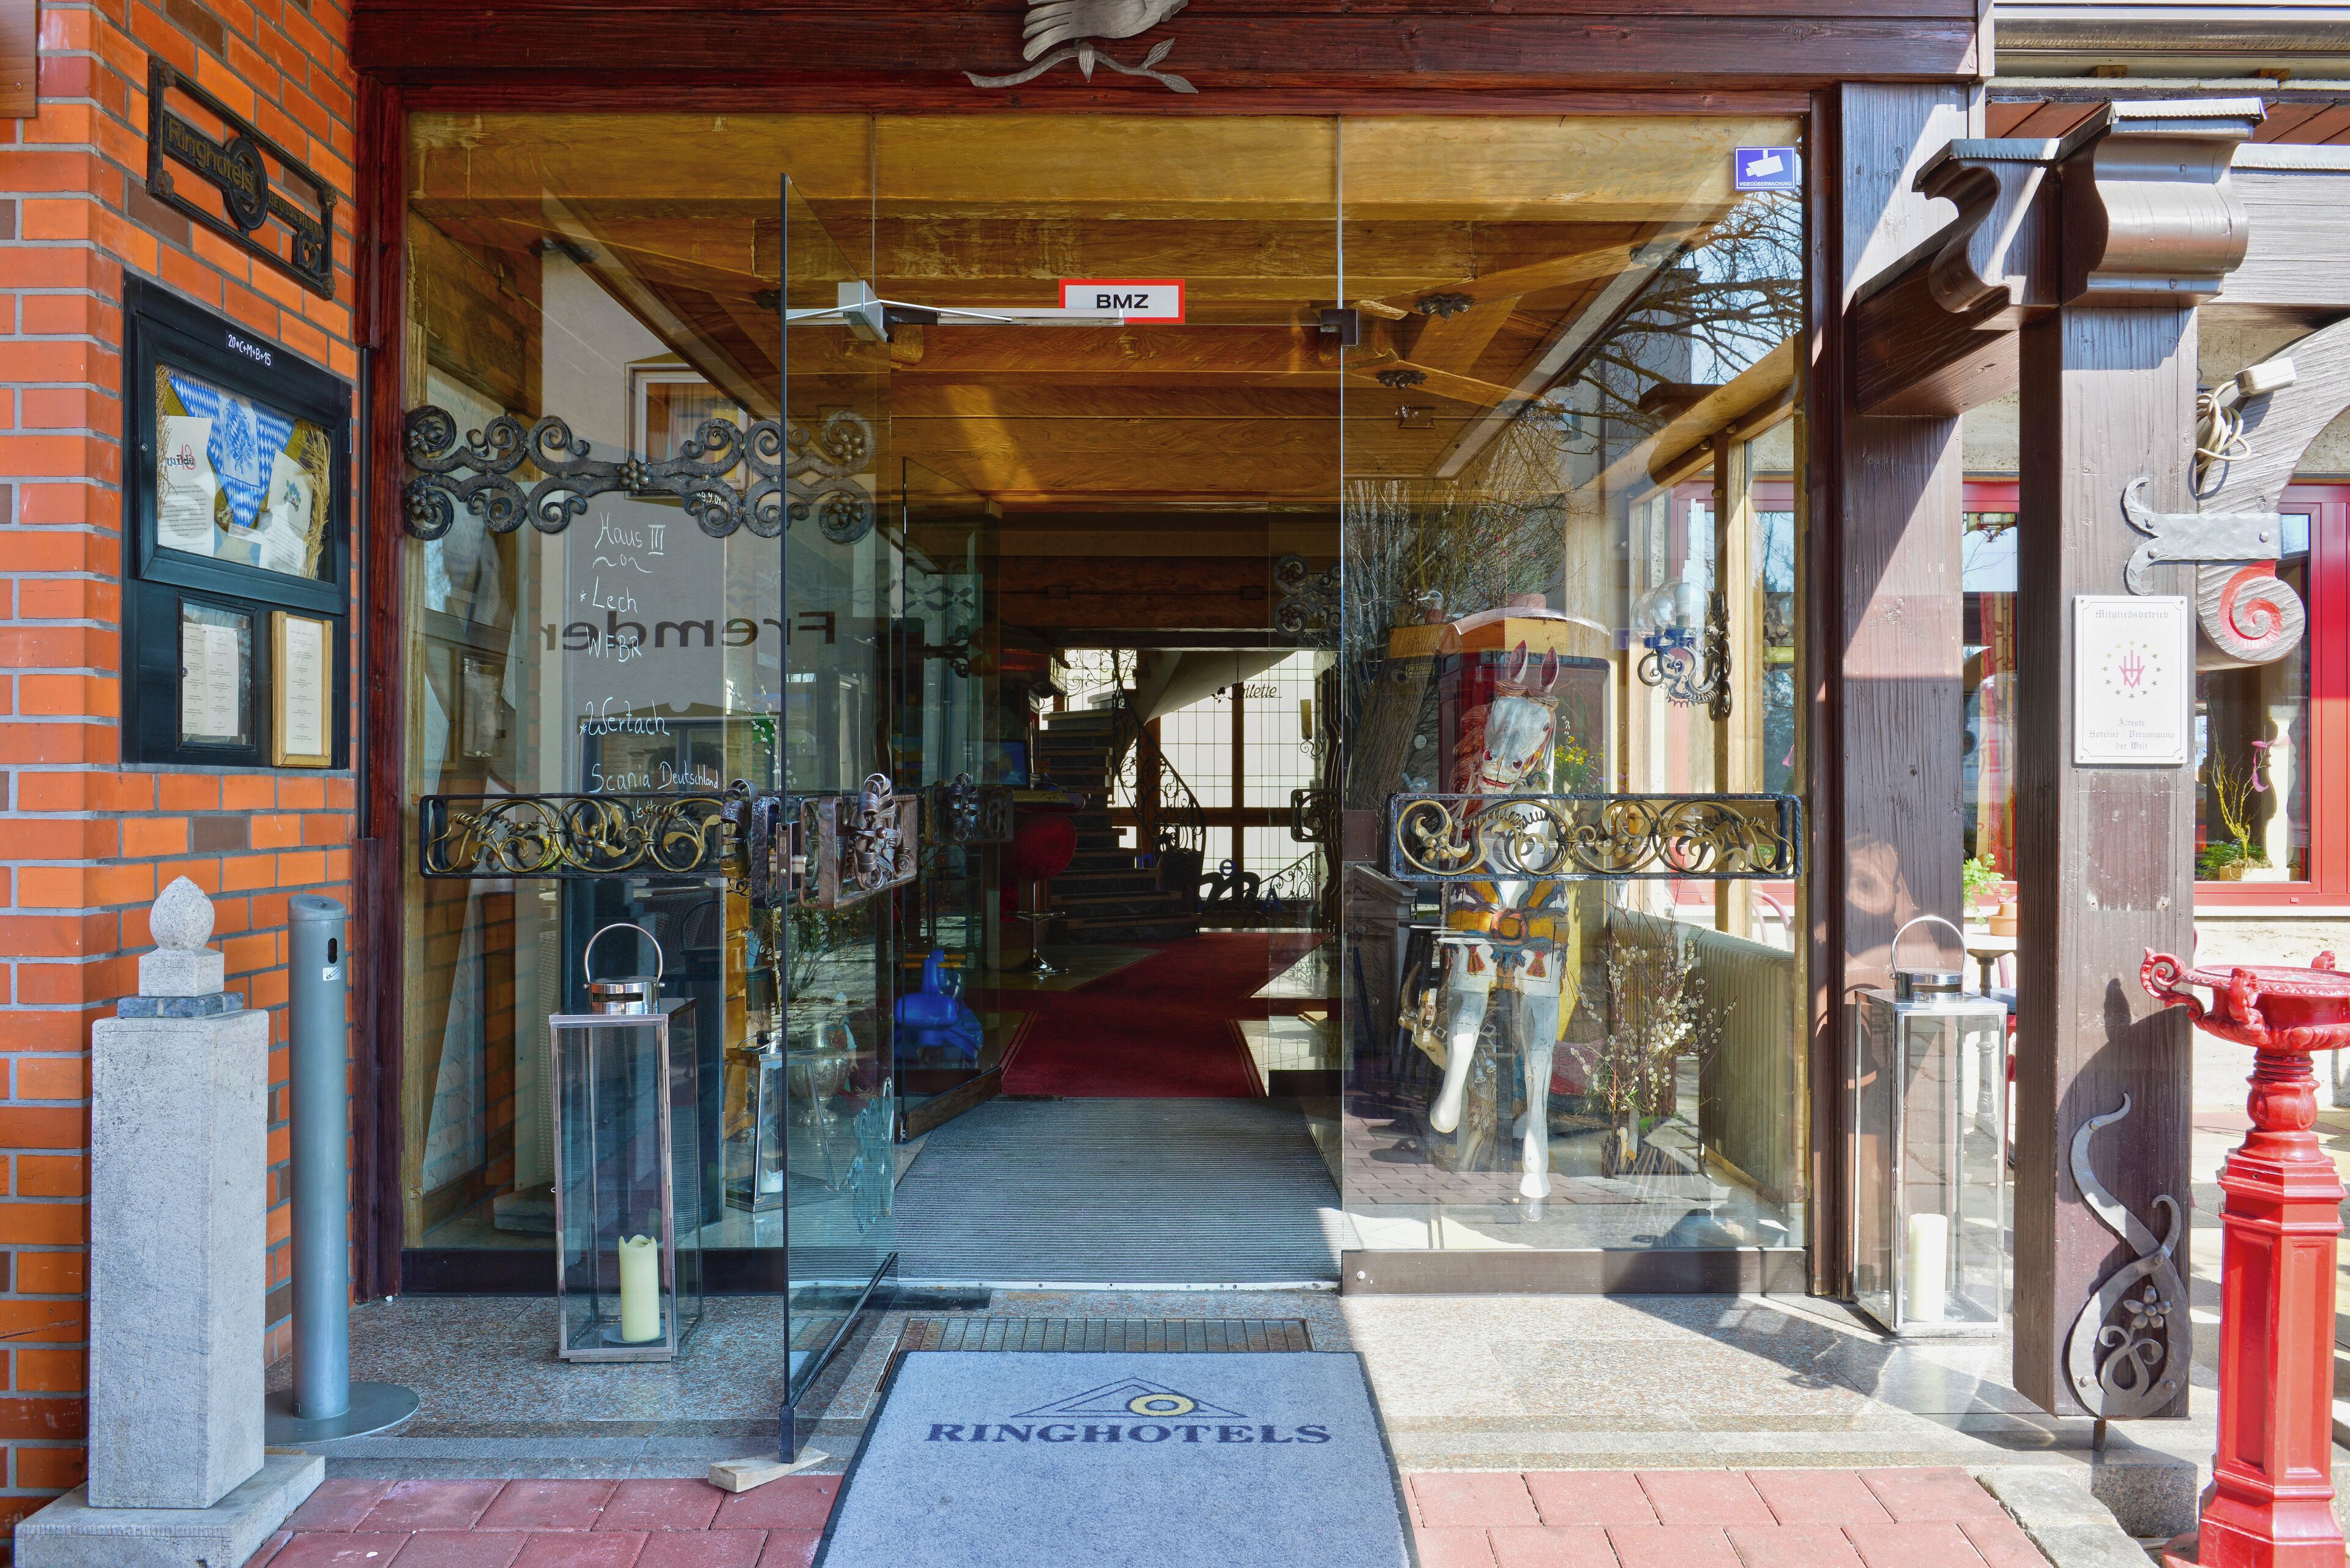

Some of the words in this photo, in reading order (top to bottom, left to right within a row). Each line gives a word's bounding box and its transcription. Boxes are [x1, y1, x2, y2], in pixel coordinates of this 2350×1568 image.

[168, 119, 255, 194] Ringhotels
[268, 190, 324, 244] DEUTSCHLAND
[1096, 294, 1149, 309] BMZ
[594, 512, 643, 550] Haus
[647, 524, 666, 556] III
[592, 576, 639, 613] Lech
[2095, 609, 2169, 620] Mitgliedsbetrieb
[1231, 682, 1278, 699] Toilette
[2119, 716, 2146, 727] Älteste
[2089, 730, 2120, 738] Hotelier
[2128, 730, 2175, 740] Vereinigung
[588, 763, 652, 794] Scania
[657, 760, 720, 790] Deutschland
[925, 1422, 1333, 1444] RINGHOTELS
